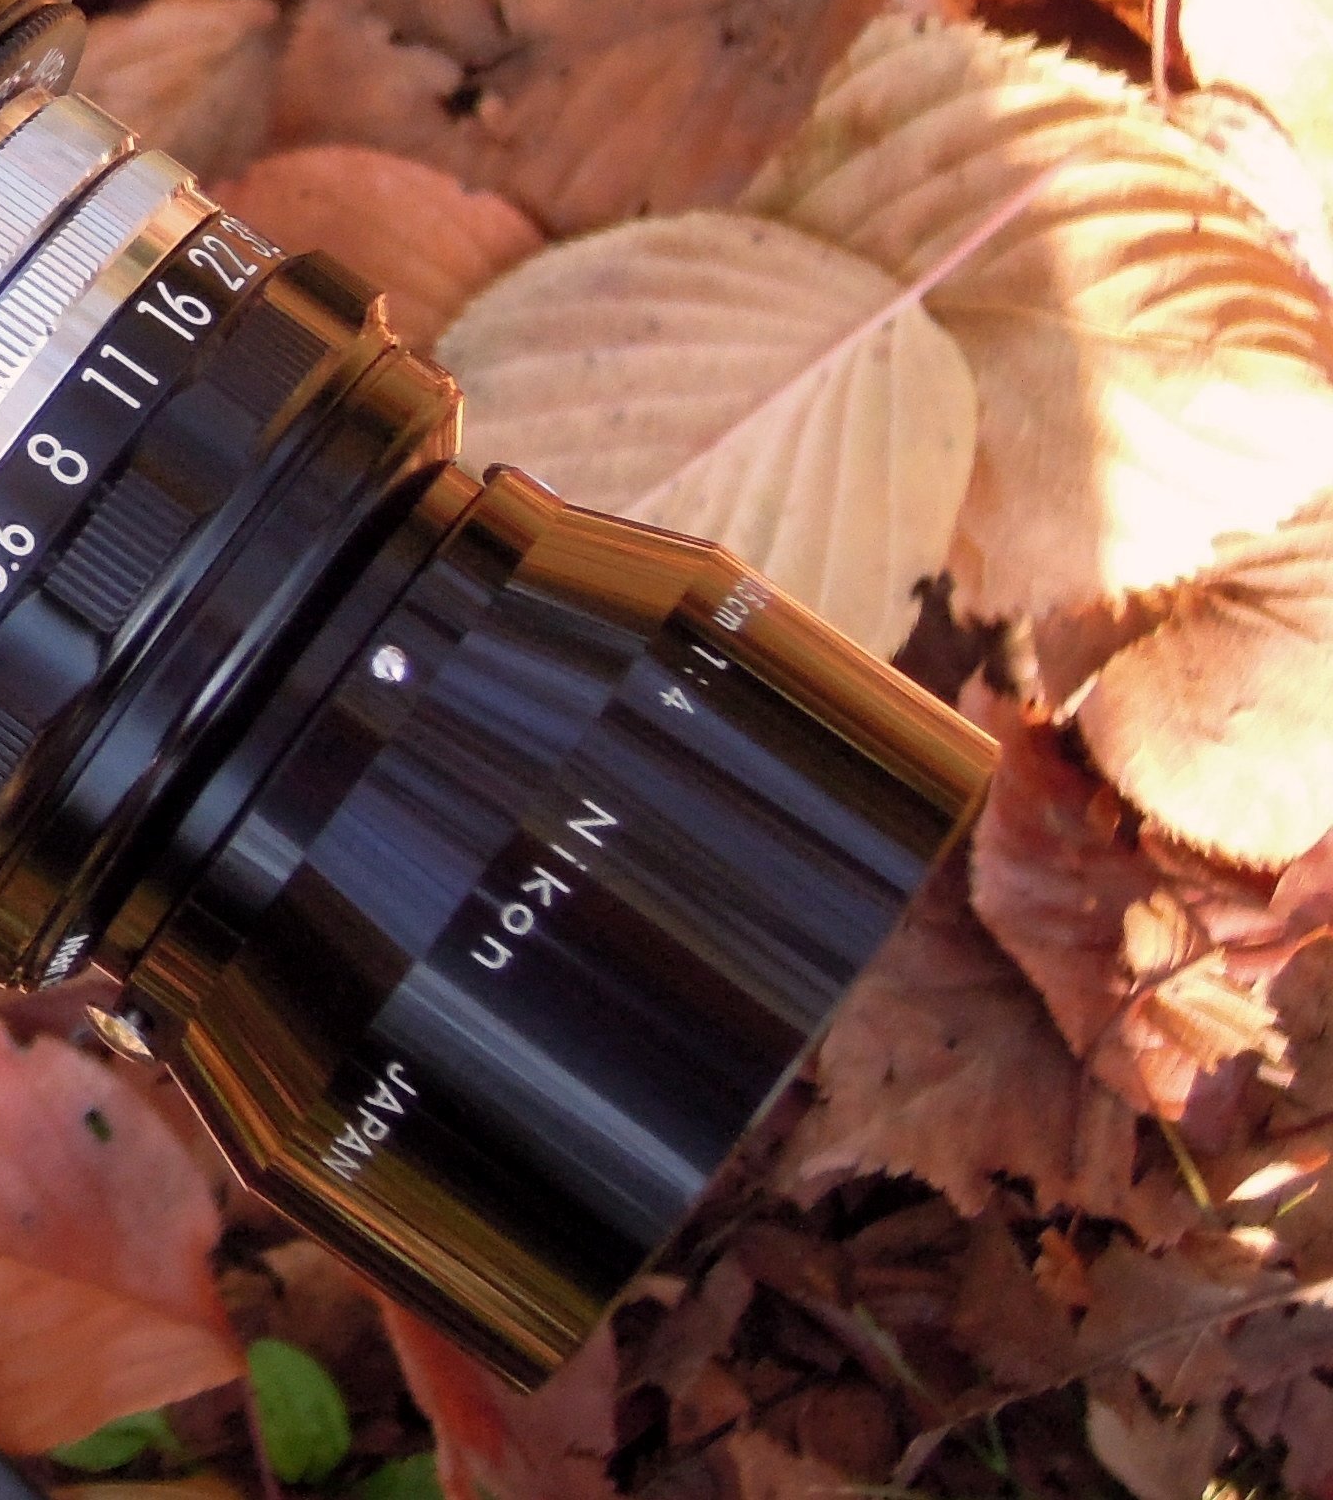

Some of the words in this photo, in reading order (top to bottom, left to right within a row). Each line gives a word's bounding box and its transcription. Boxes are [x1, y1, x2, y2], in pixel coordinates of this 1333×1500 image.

[188, 235, 259, 292] 22
[136, 281, 212, 342] 16
[80, 343, 160, 410] 11
[26, 433, 89, 486] 8
[470, 798, 619, 971] Nikon
[321, 1061, 419, 1182] JAPAN
